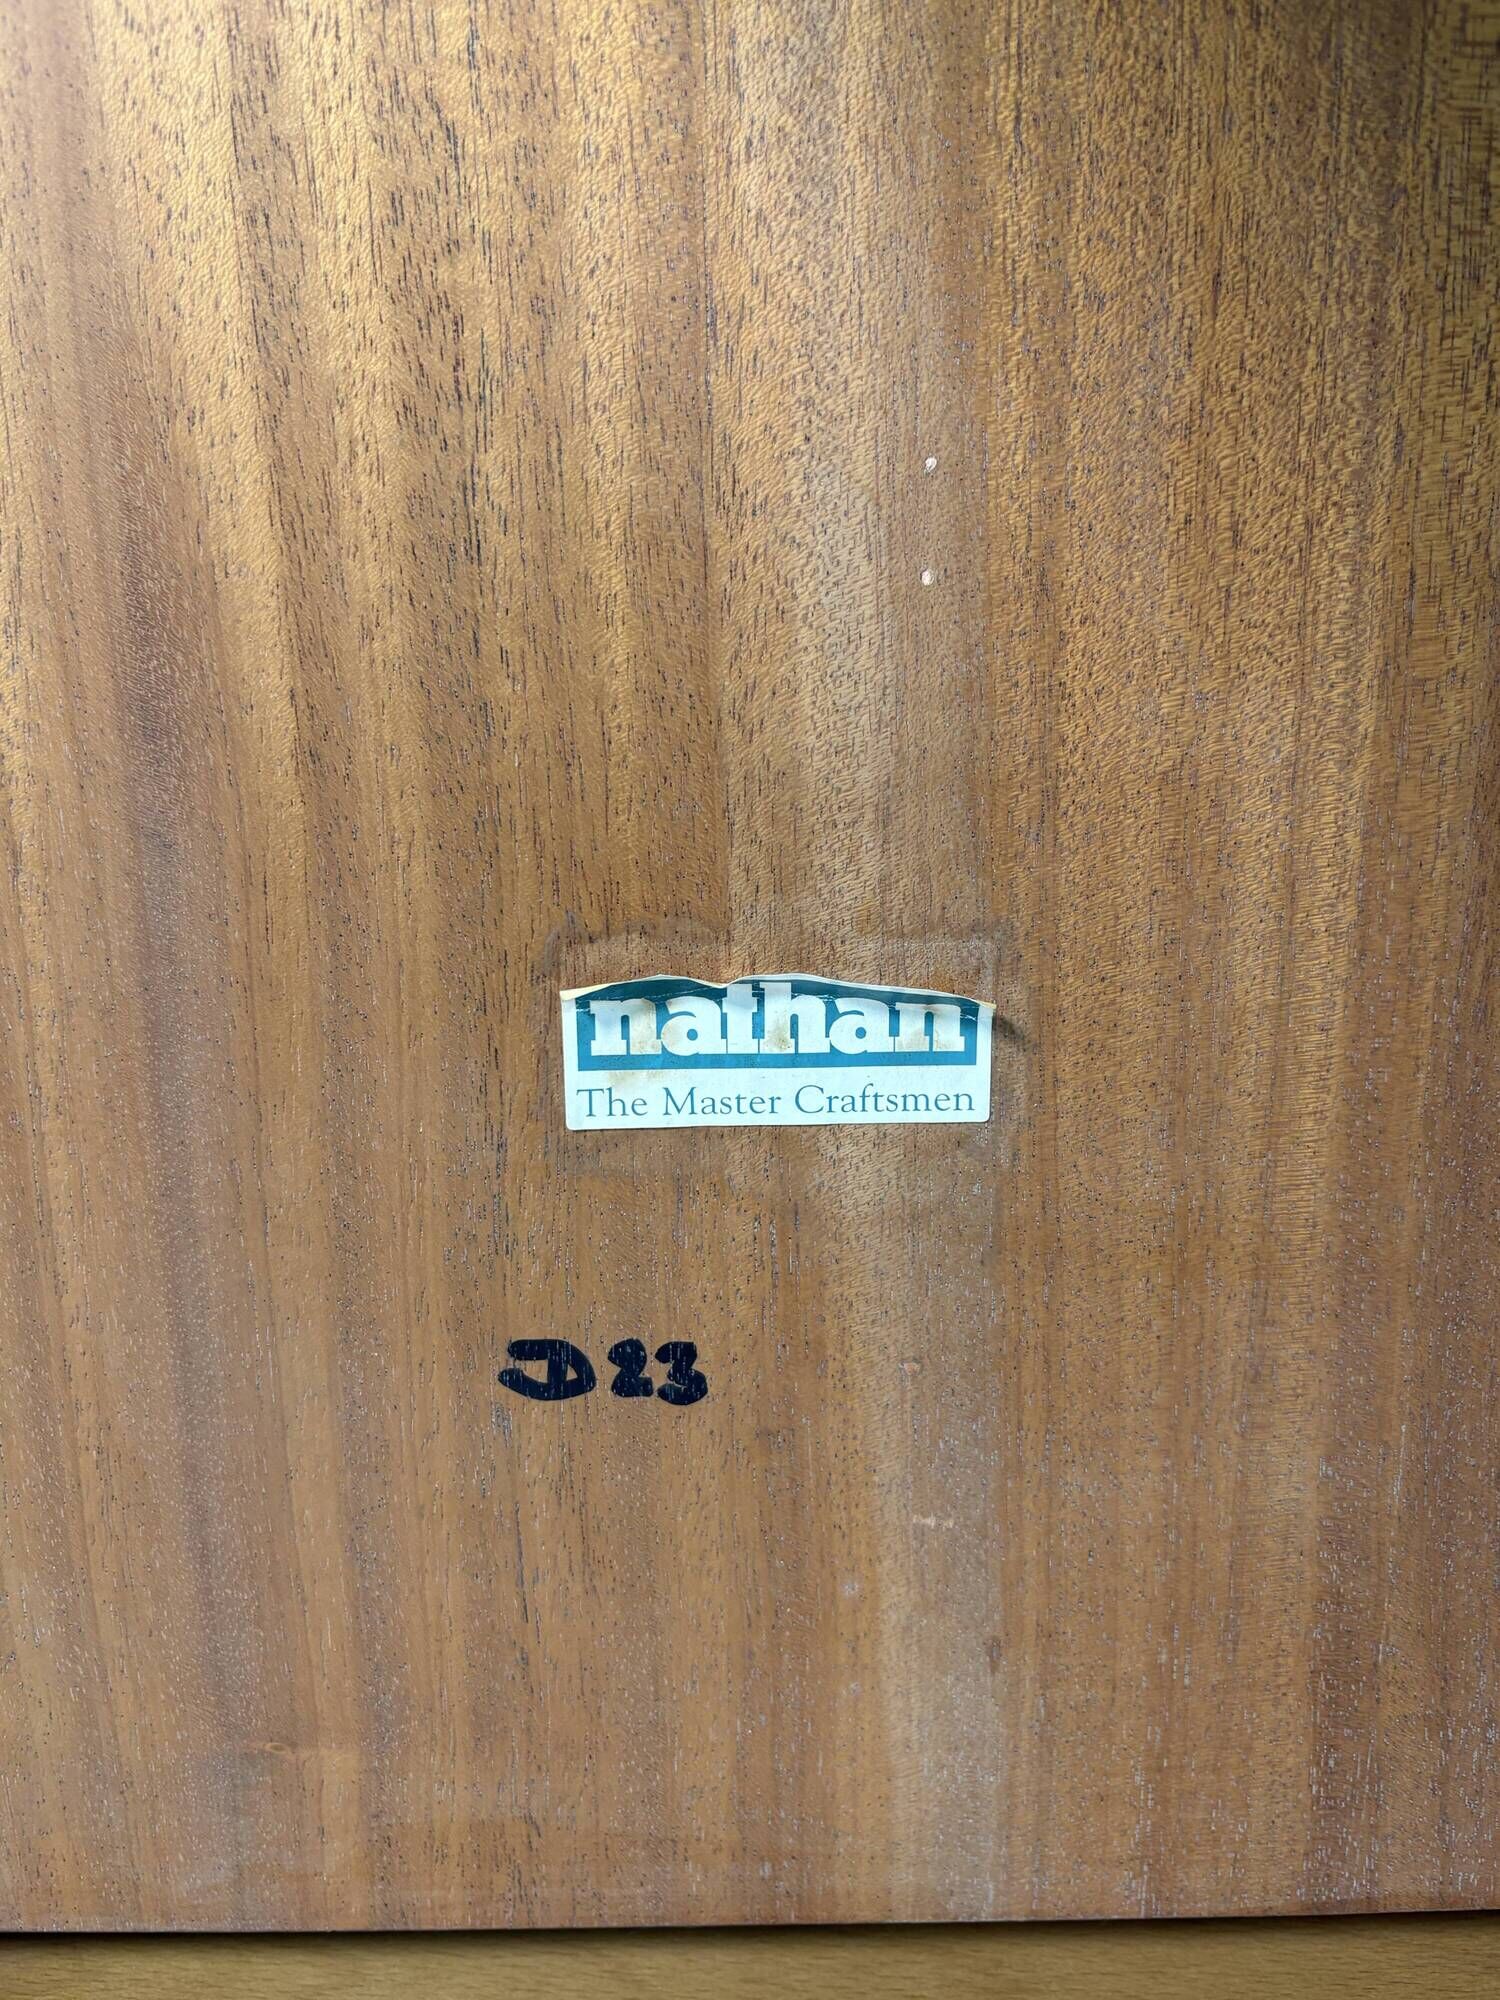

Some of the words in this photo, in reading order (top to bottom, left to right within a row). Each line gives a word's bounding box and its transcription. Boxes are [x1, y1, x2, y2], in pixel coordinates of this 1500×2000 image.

[590, 981, 965, 1057] nathan
[576, 1087, 648, 1117] The
[662, 1086, 781, 1116] Master
[795, 1083, 975, 1114] Craftsmen
